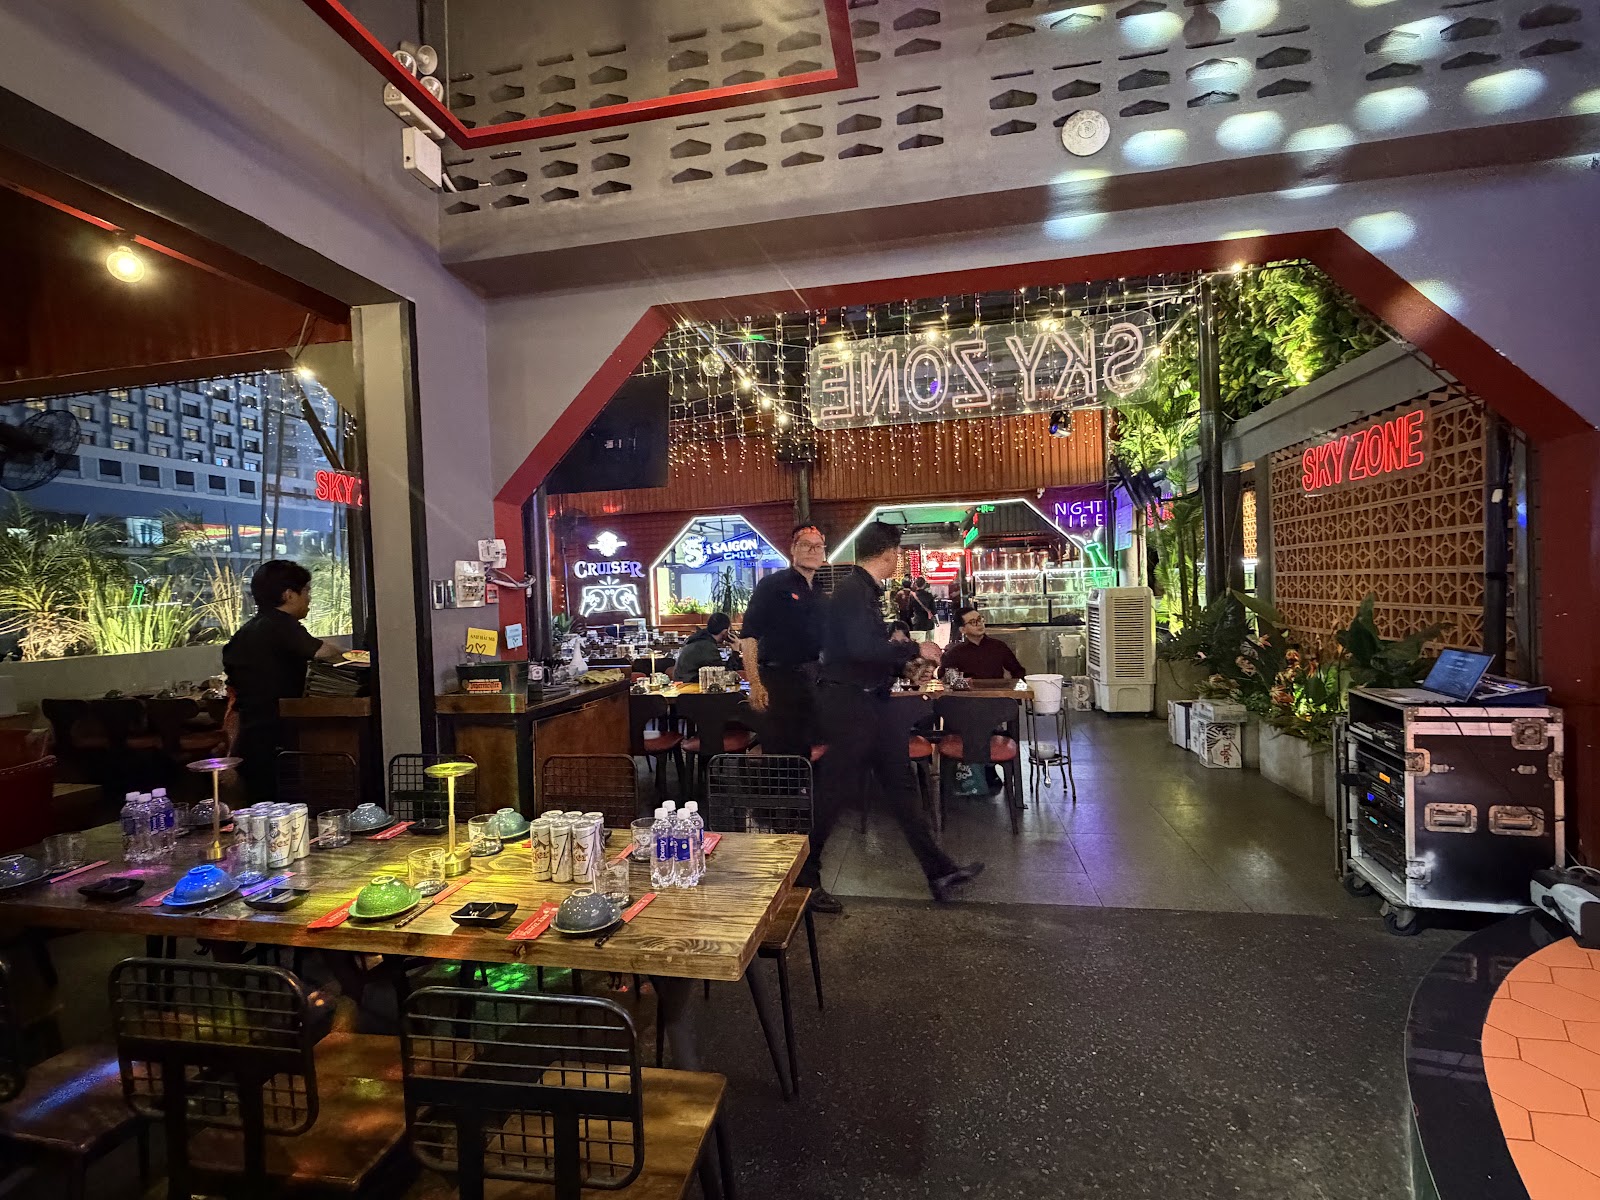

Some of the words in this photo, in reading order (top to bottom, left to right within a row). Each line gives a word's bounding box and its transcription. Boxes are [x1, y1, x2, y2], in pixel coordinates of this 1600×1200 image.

[1302, 435, 1350, 492] SKY
[1349, 409, 1425, 481] ZONE
[315, 470, 356, 505] SKY
[1055, 500, 1103, 515] NIGHT
[711, 539, 758, 554] SAIGON
[723, 551, 757, 561] CHILL
[574, 561, 646, 579] CRUISER
[1219, 742, 1233, 766] Tiger
